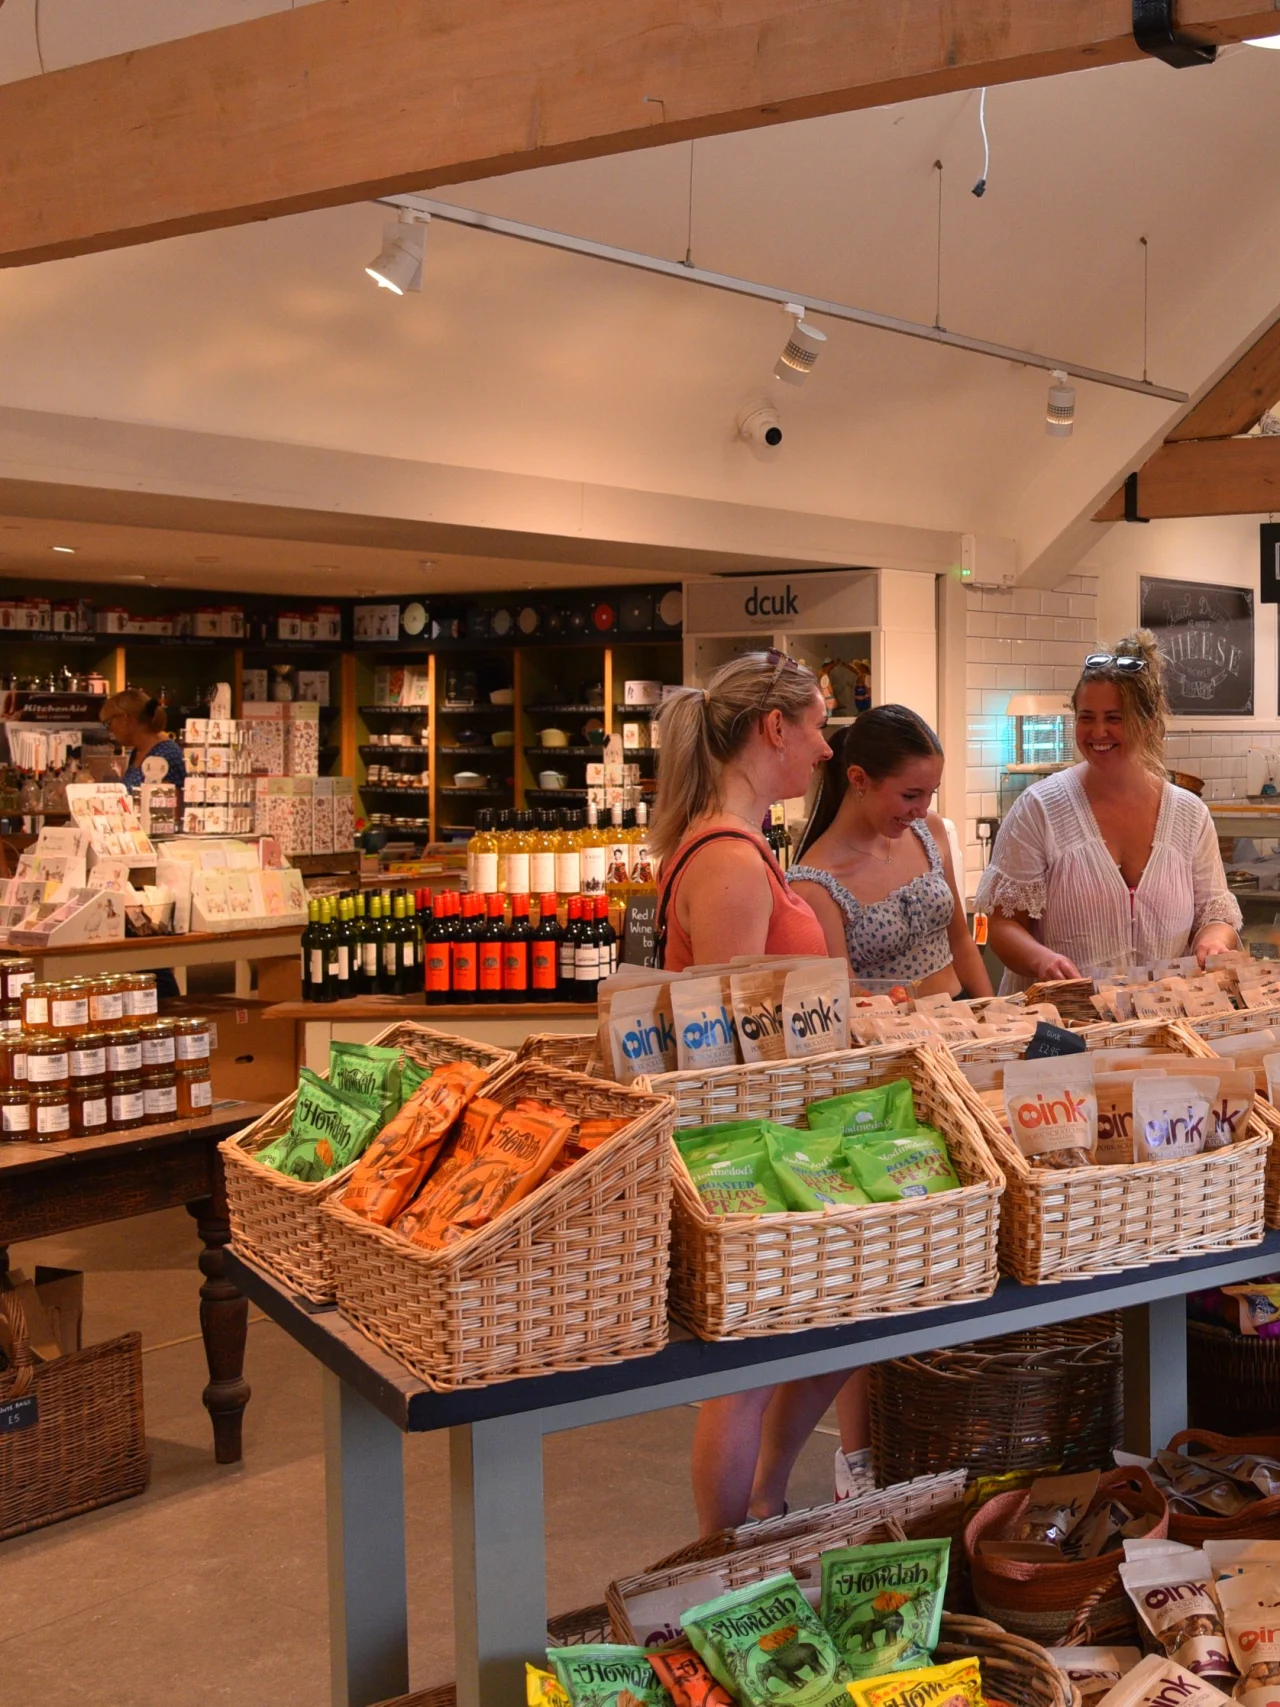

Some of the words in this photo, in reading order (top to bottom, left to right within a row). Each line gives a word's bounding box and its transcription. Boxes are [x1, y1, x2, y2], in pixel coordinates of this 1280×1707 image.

[745, 585, 799, 616] dcuk
[23, 704, 88, 713] KitchenAid
[630, 921, 653, 934] Wine
[631, 908, 649, 921] Red
[622, 1013, 677, 1060] oink
[300, 1098, 352, 1151] Howdah
[1017, 1089, 1088, 1129] oink
[1145, 1105, 1204, 1147] oink
[704, 1197, 767, 1215] PEAS
[836, 1563, 928, 1596] Howdah
[710, 1595, 797, 1640] Howdah
